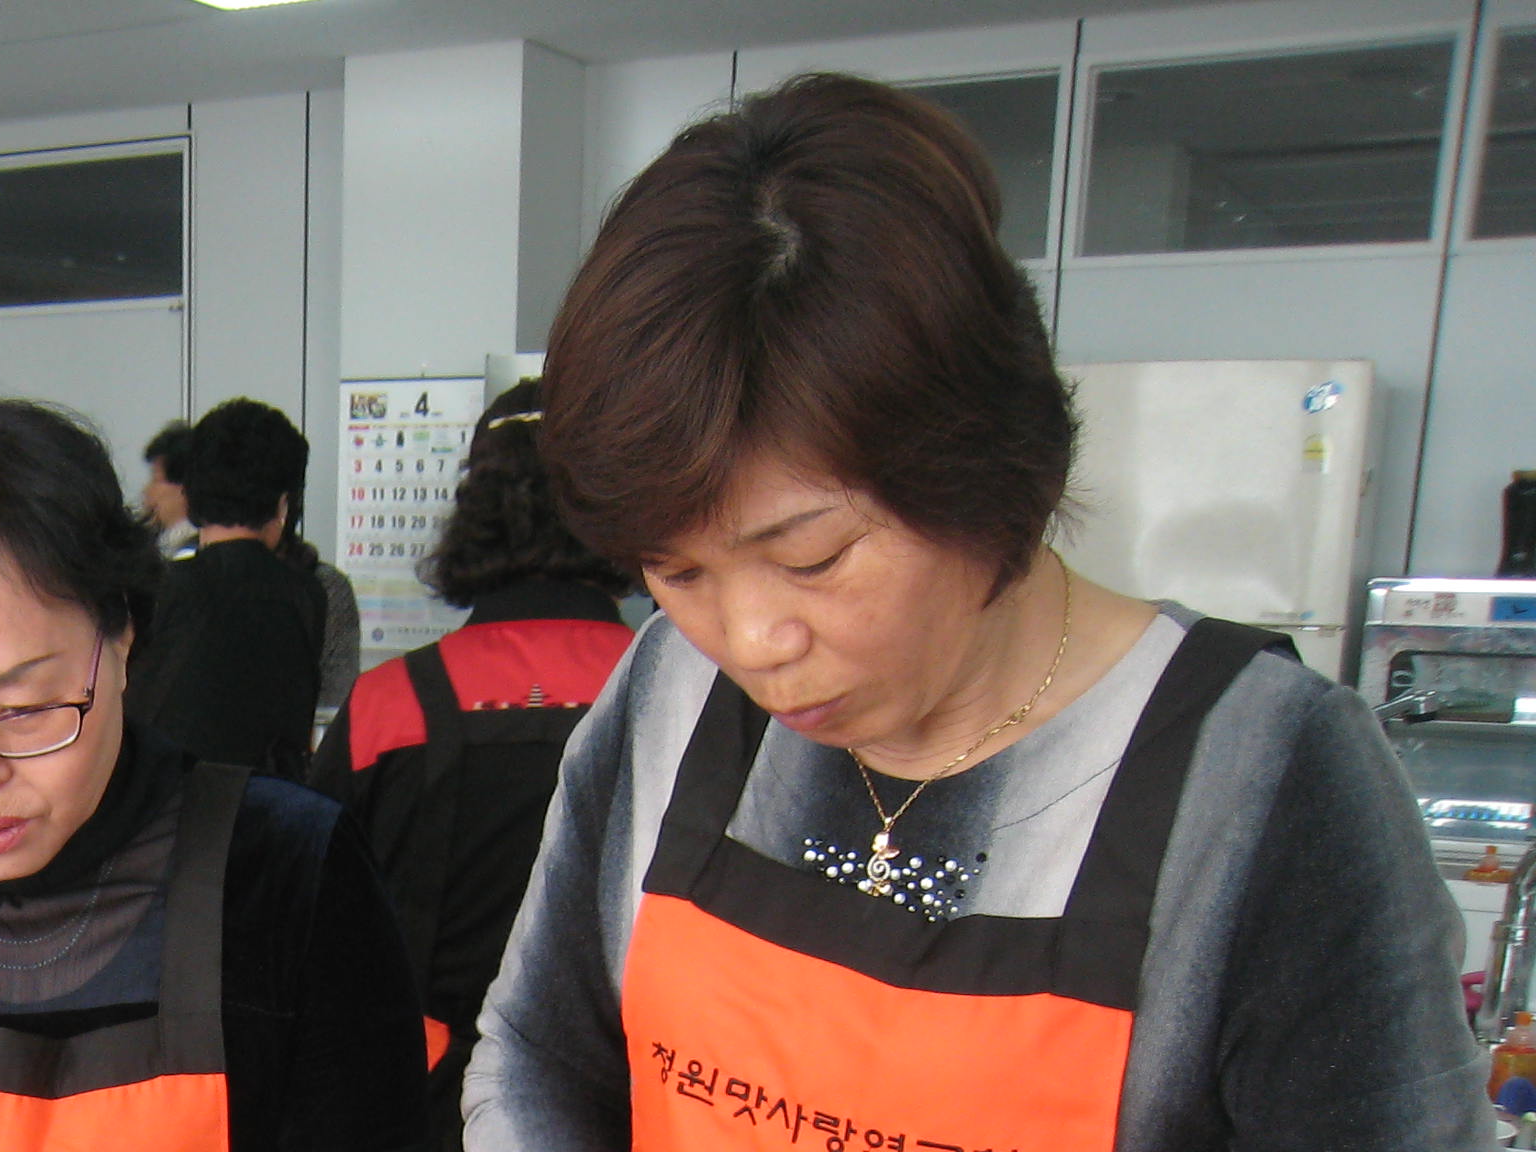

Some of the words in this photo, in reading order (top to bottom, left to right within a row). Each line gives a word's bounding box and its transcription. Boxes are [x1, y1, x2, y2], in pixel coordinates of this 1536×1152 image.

[414, 392, 429, 416] 4
[354, 459, 363, 473] 3
[375, 459, 383, 473] 4
[396, 459, 404, 473] 5
[416, 459, 425, 473] 6
[437, 459, 445, 473] 7
[351, 487, 365, 501] 10
[372, 487, 385, 501] 11
[393, 487, 406, 501] 12
[413, 487, 427, 501] 13
[434, 487, 448, 501] 14
[350, 515, 364, 529] 17
[370, 515, 384, 529] 18
[392, 515, 406, 529] 19
[411, 515, 426, 529] 20
[348, 543, 364, 557] 24
[369, 543, 384, 557] 25
[389, 543, 404, 557] 26
[410, 543, 425, 557] 27
